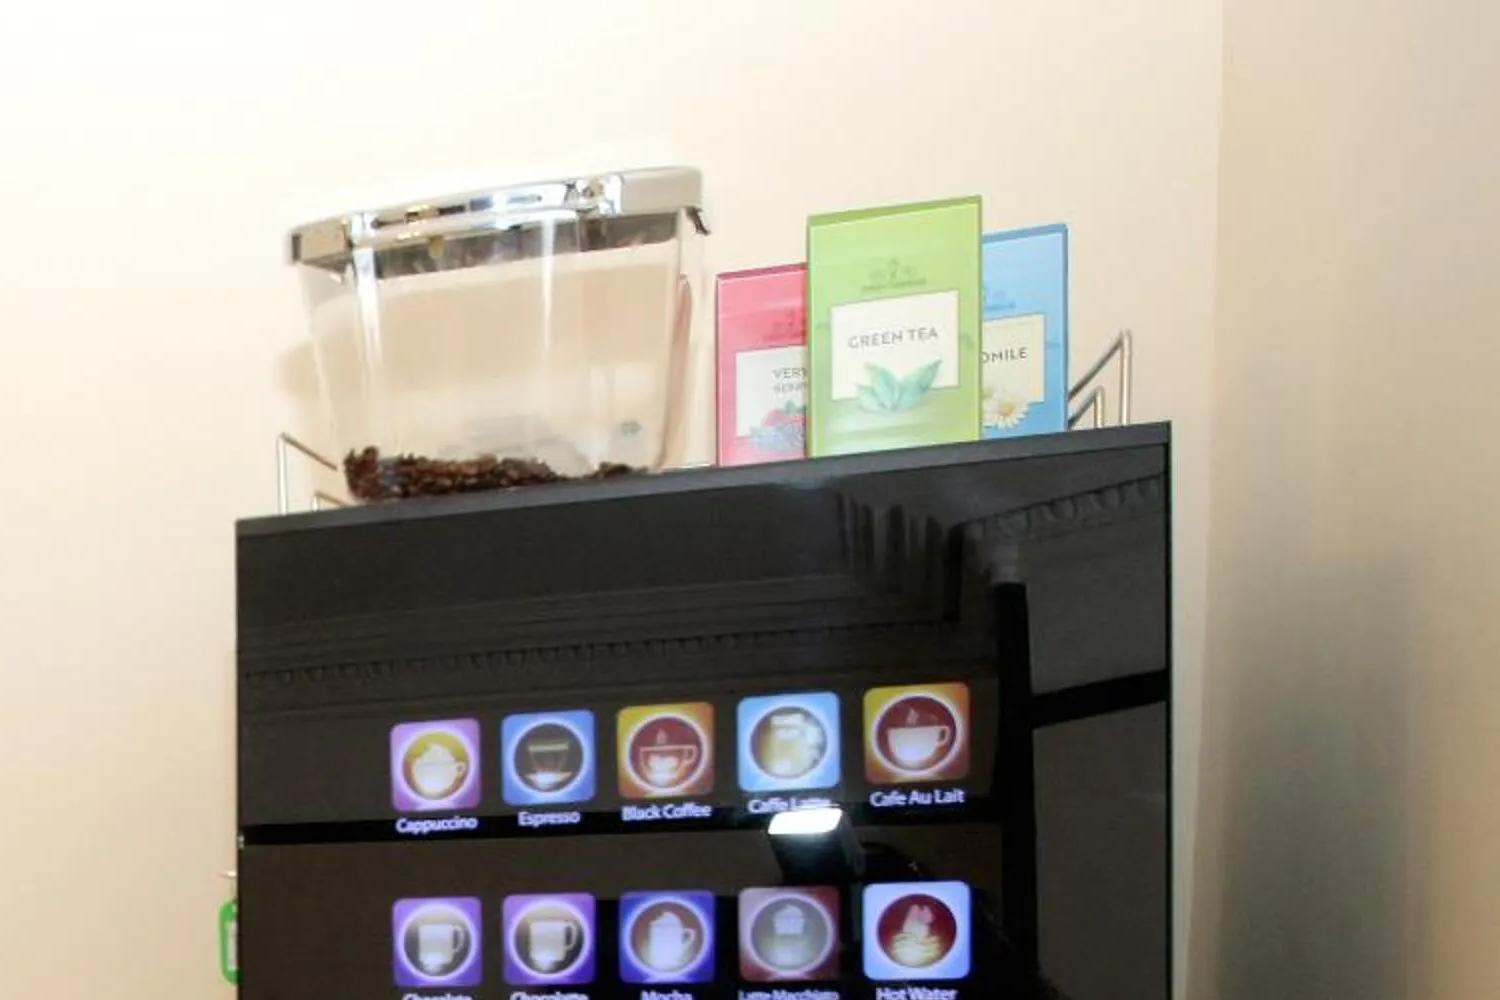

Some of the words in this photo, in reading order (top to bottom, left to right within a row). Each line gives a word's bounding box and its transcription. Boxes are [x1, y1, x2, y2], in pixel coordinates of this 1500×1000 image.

[847, 329, 904, 350] GREEN
[907, 326, 940, 342] TEA
[933, 787, 966, 804] Lait
[518, 811, 581, 827] Espresso
[621, 804, 661, 821] Black
[663, 802, 712, 819] Coffee
[396, 816, 478, 834] Cappuccino
